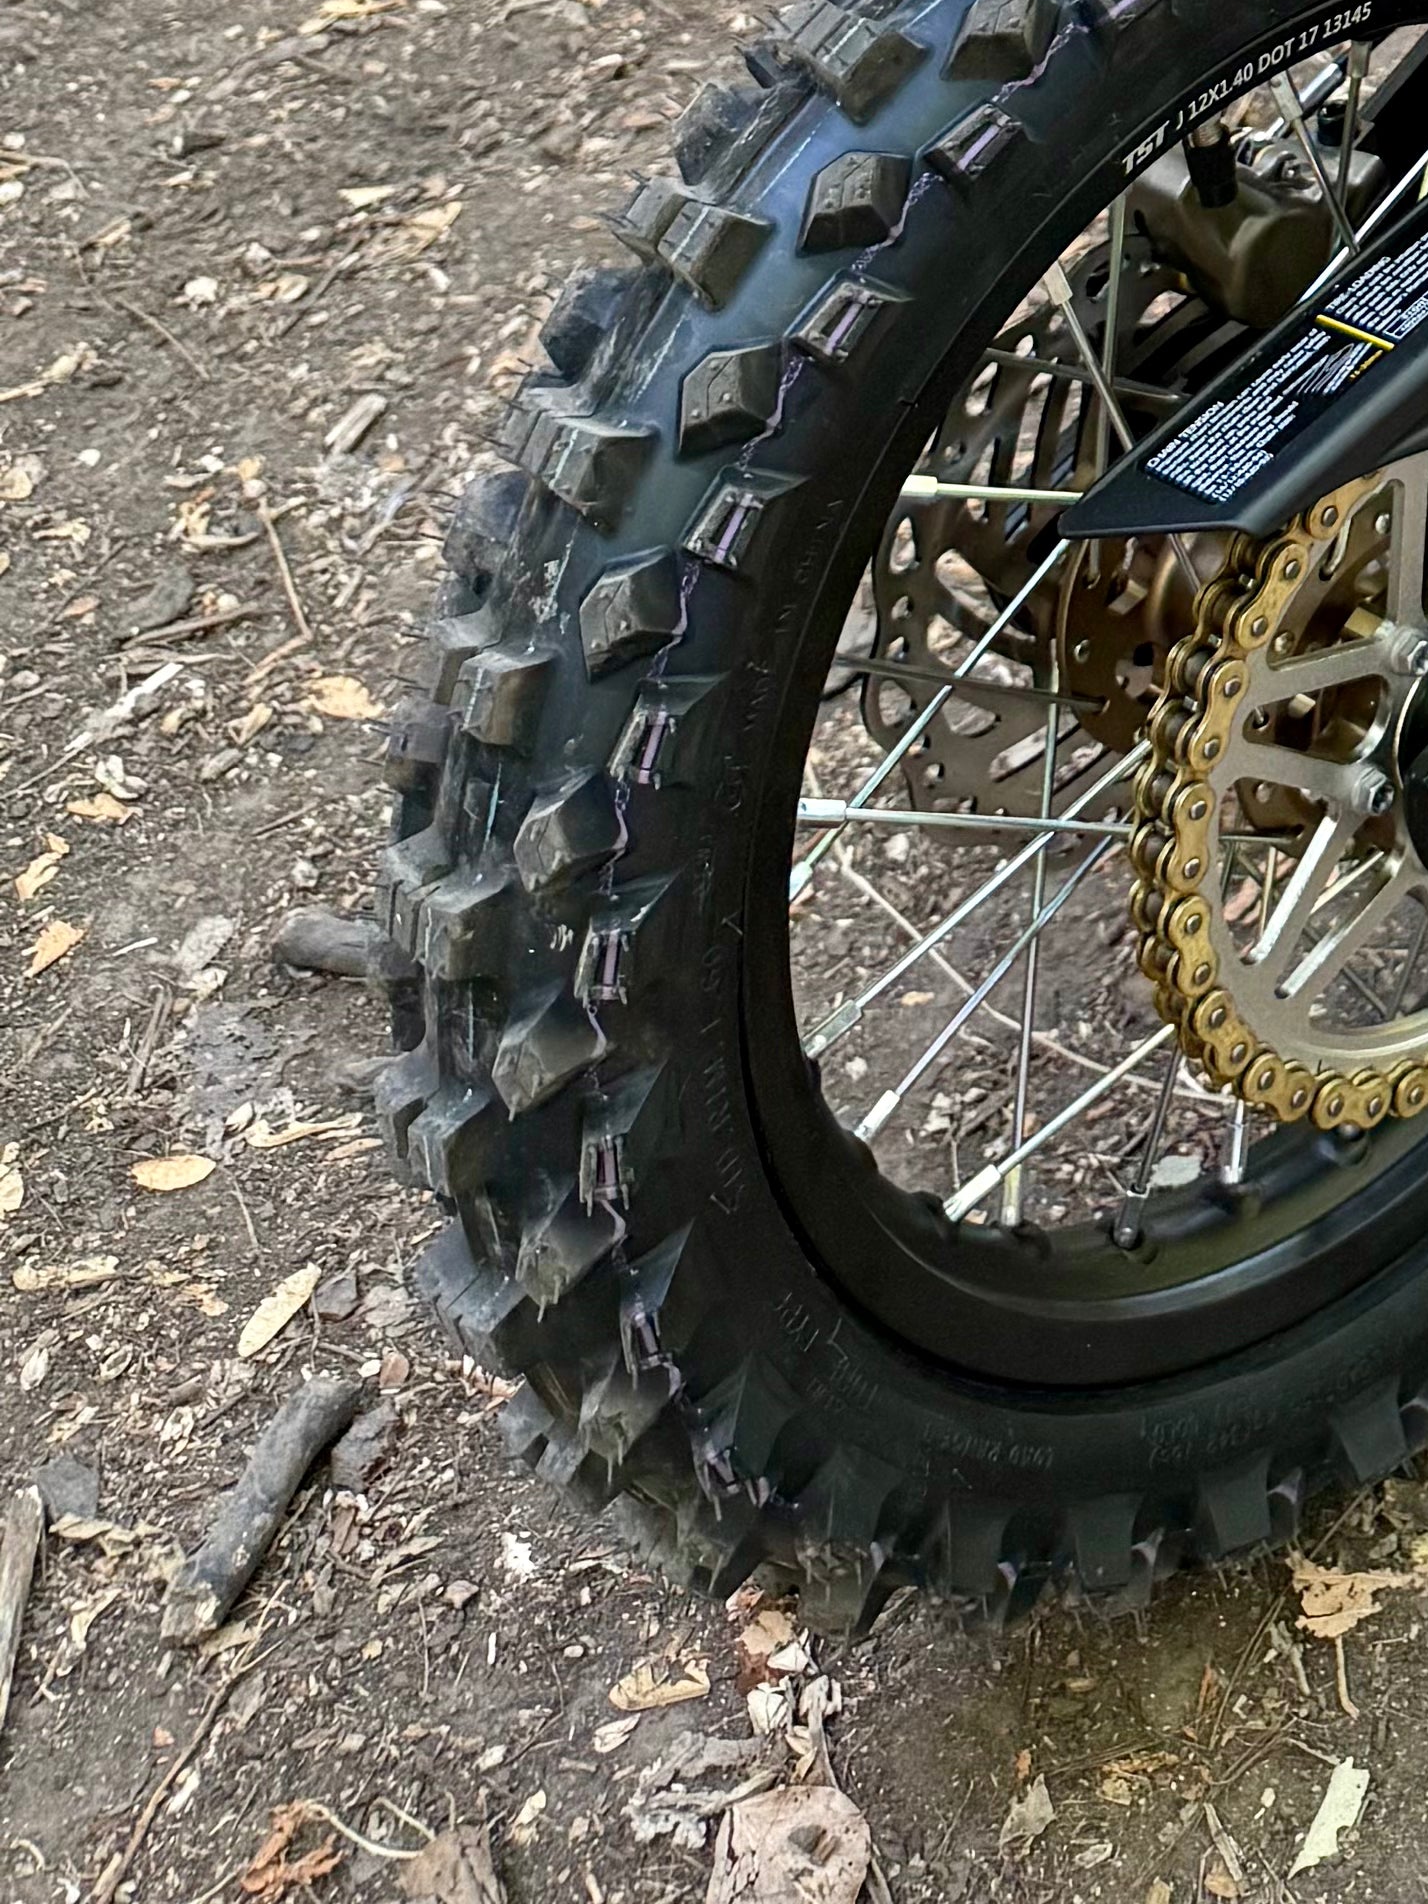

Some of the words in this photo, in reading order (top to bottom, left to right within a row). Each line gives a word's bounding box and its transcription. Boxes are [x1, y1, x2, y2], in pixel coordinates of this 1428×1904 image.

[1121, 120, 1170, 176] TST
[1187, 62, 1253, 118] 12X1.40
[1257, 38, 1296, 73] DOT
[1298, 26, 1318, 51] 17
[1322, 1, 1372, 39] 13145
